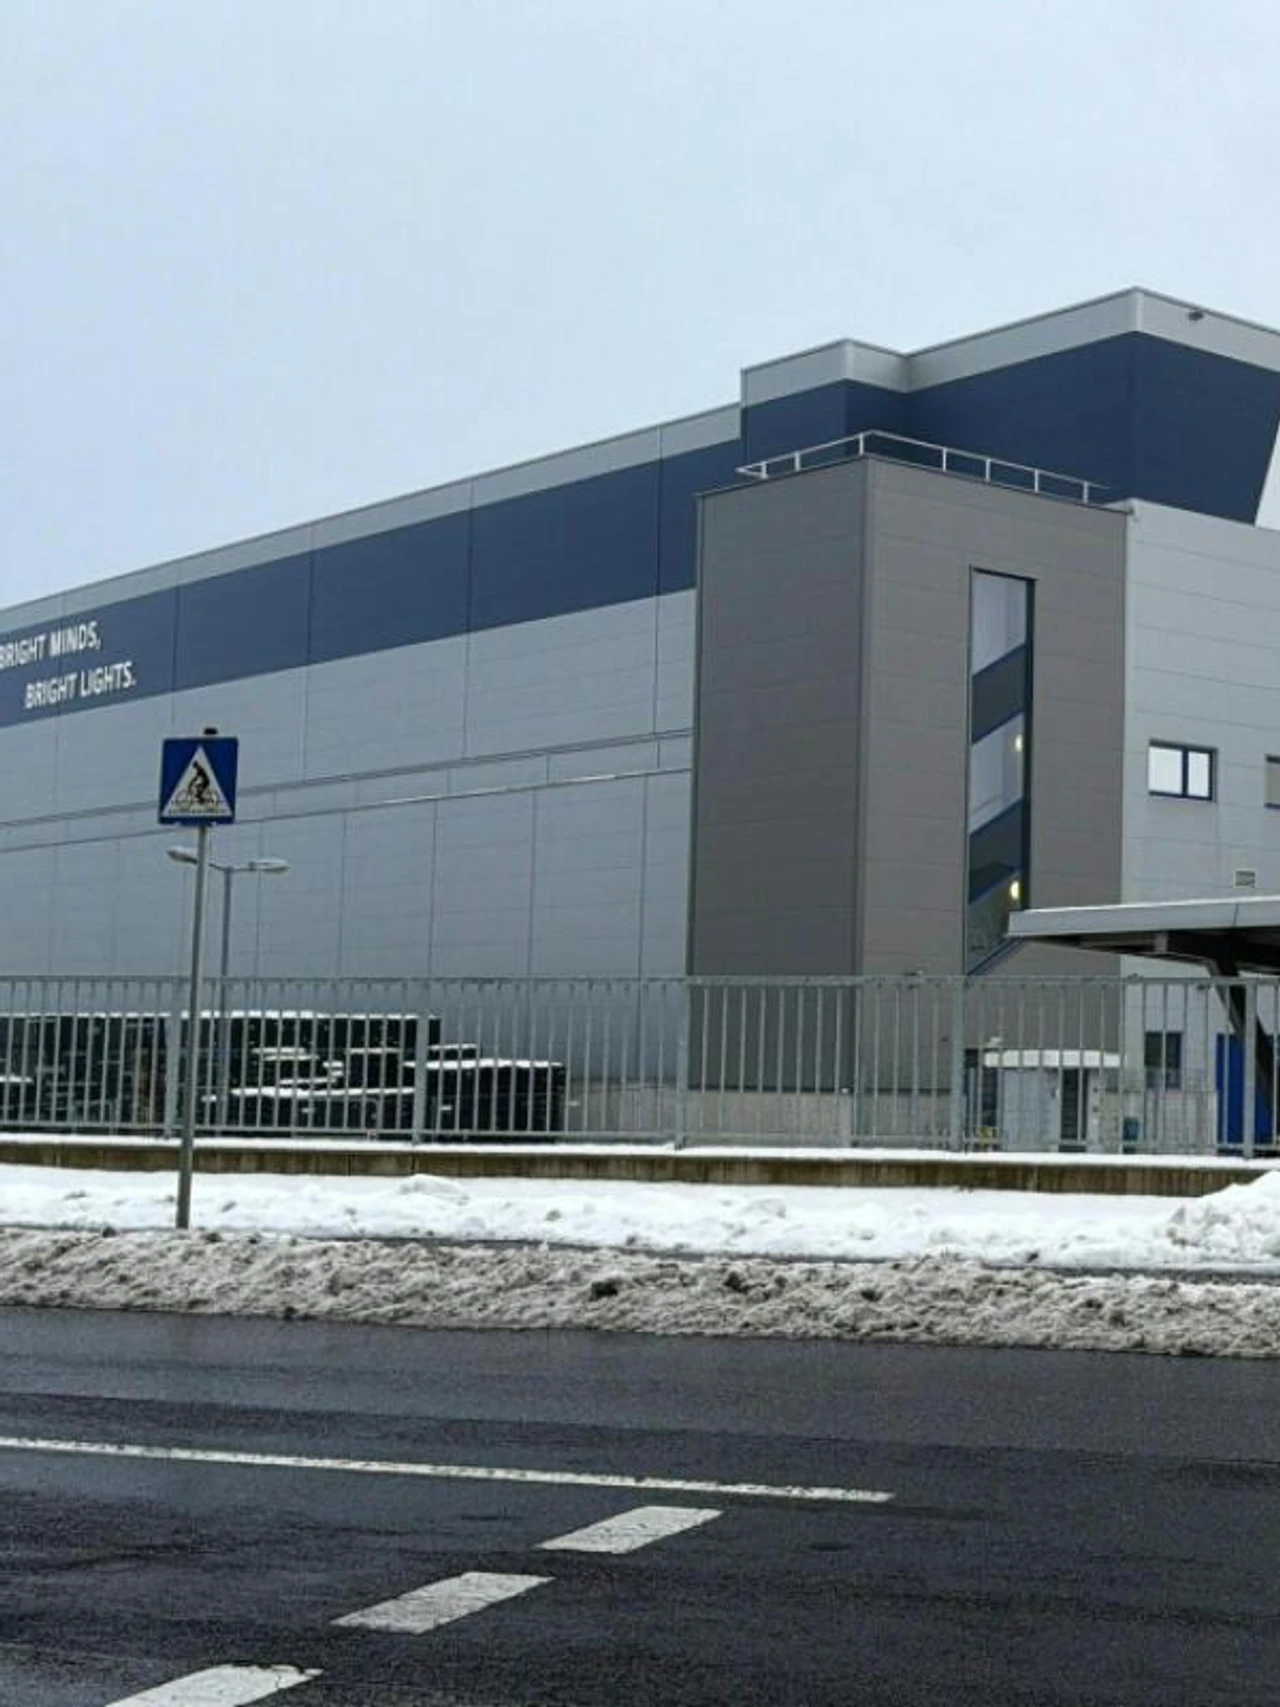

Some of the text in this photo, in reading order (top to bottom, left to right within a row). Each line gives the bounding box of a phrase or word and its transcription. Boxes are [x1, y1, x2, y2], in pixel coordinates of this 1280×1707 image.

[49, 620, 102, 658] MINDS,
[25, 661, 136, 709] BRIGHT LIGHTS.
